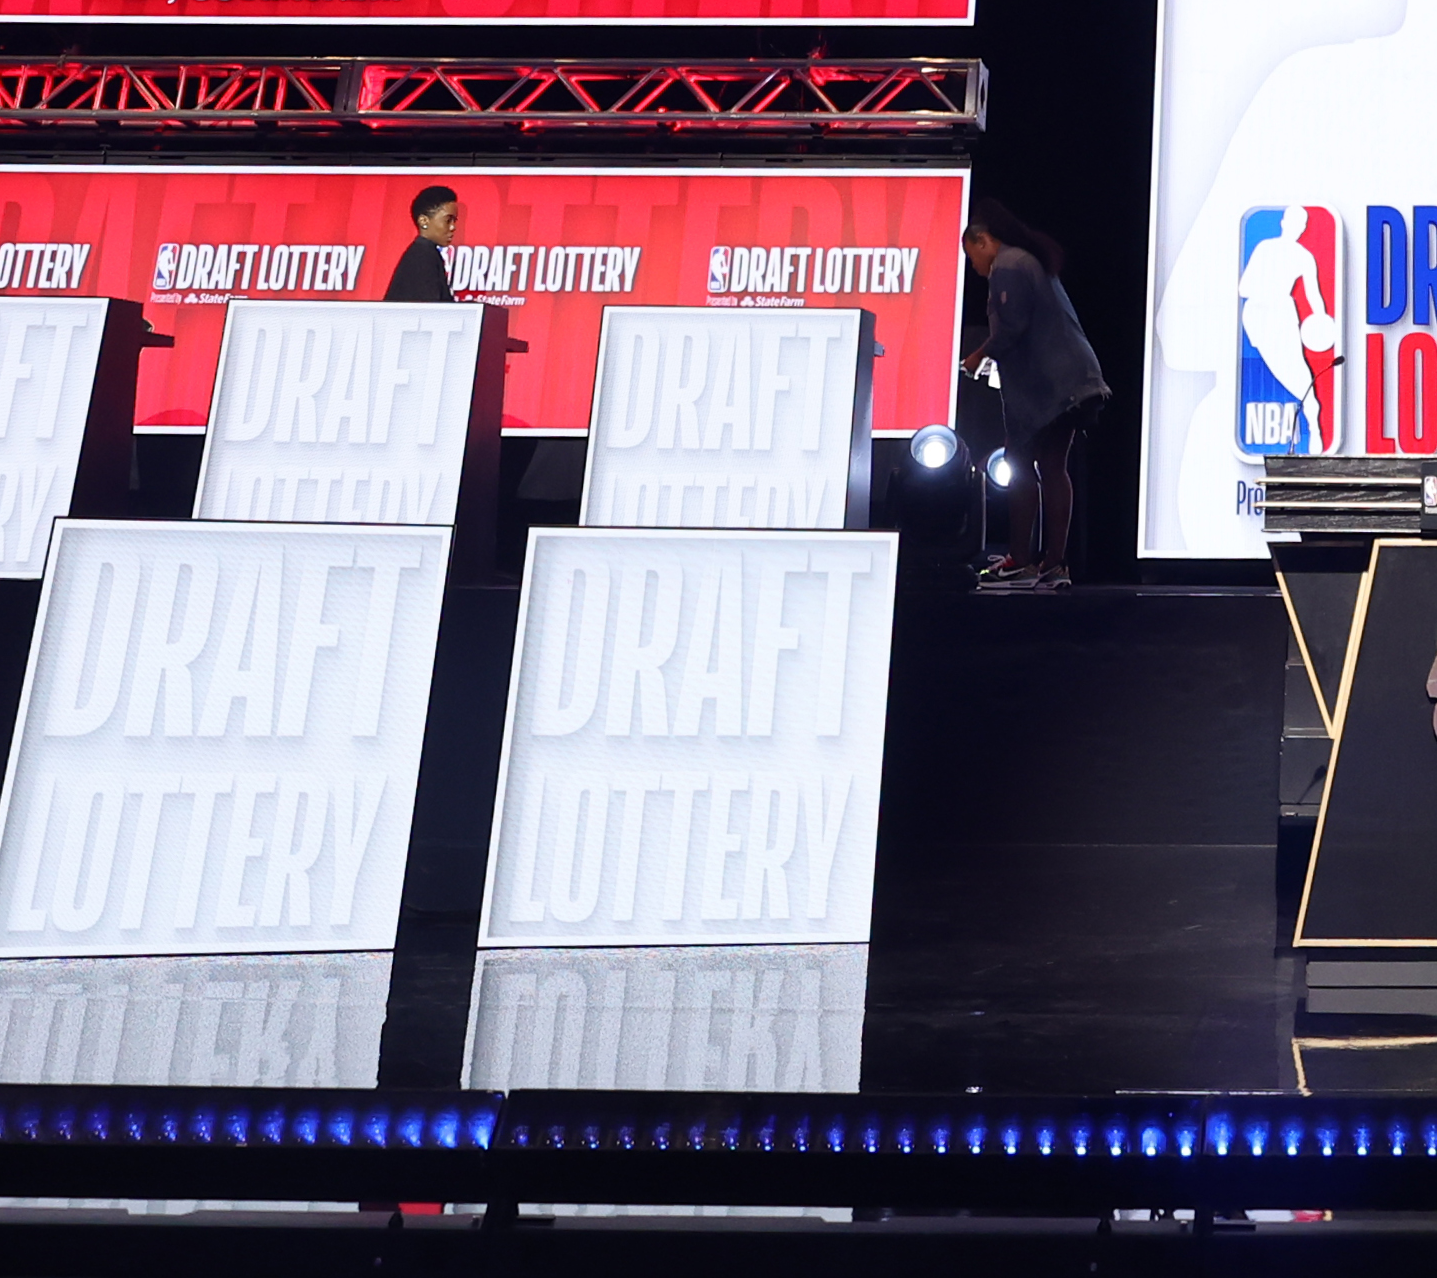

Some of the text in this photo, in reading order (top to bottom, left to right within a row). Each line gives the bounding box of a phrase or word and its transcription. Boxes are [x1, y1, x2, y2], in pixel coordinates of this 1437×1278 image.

[175, 243, 366, 291] DRAFT LOTTERY
[452, 245, 641, 293] DRAFT LOTTERY
[729, 246, 920, 293] DRAFT LOTTERY
[223, 315, 467, 445] DRAFT
[605, 321, 844, 452] DRAFT
[1244, 401, 1301, 446] NBA
[42, 540, 426, 741] DRAFT
[529, 546, 875, 739] DRAFT
[6, 771, 390, 934] LOTTERY
[508, 771, 855, 925] LOTTERY
